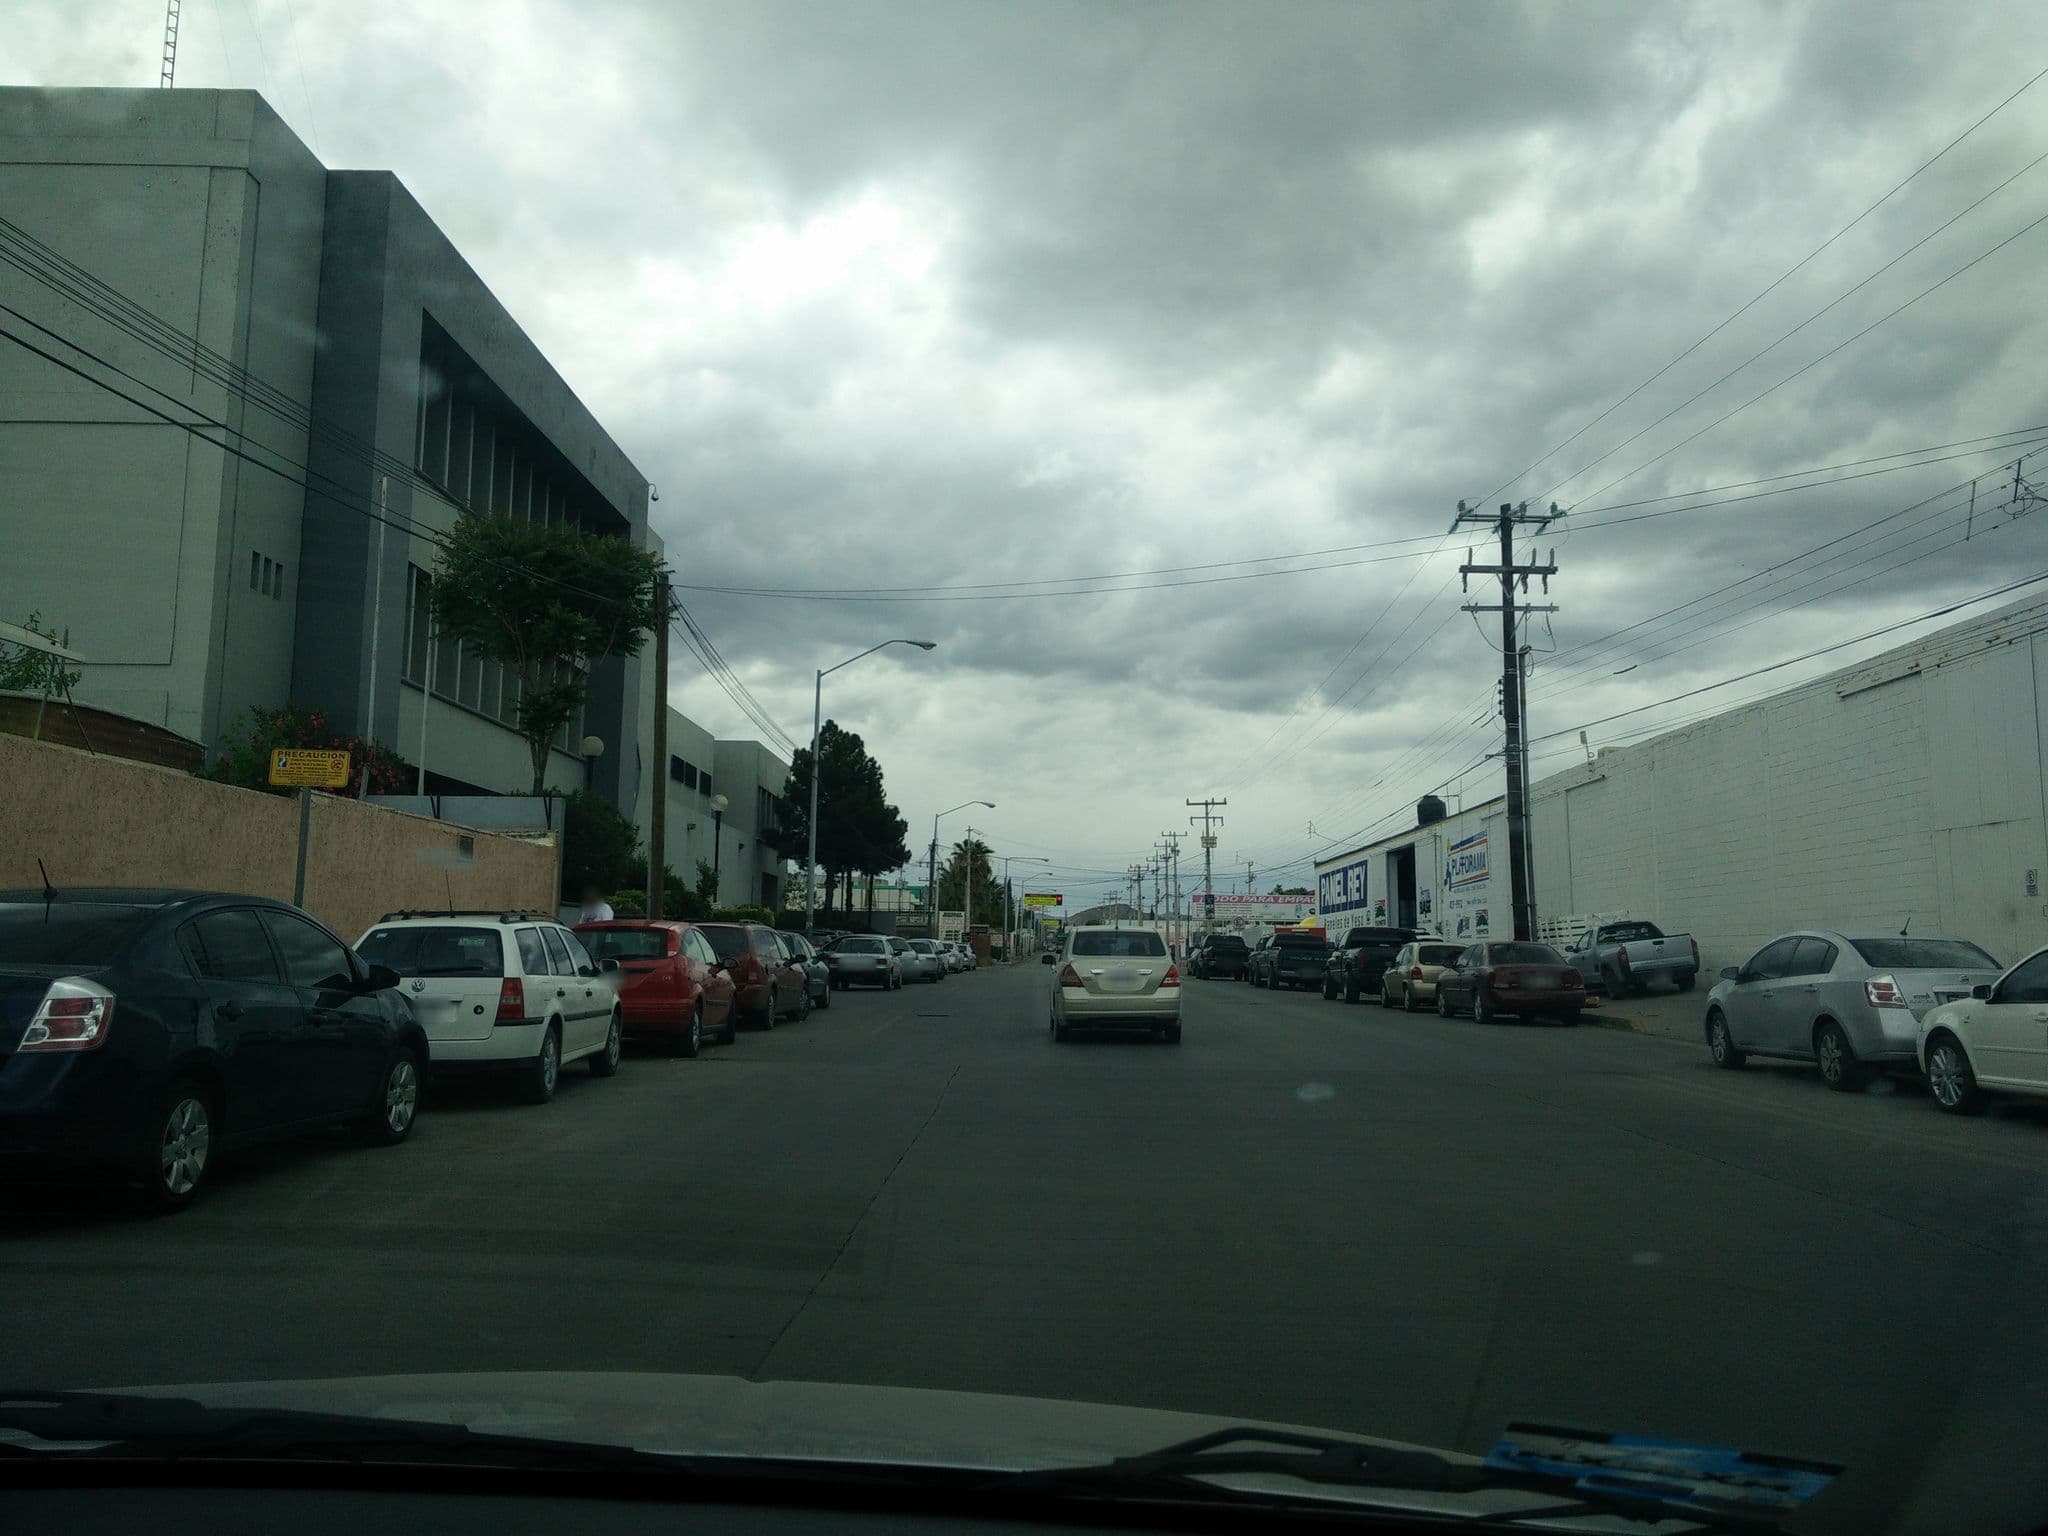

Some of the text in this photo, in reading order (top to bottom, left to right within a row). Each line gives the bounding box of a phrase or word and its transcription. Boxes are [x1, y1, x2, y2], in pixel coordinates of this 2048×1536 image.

[277, 751, 346, 759] PRECAUCION
[1321, 864, 1366, 907] PANEL REY
[1242, 895, 1274, 903] PARA
